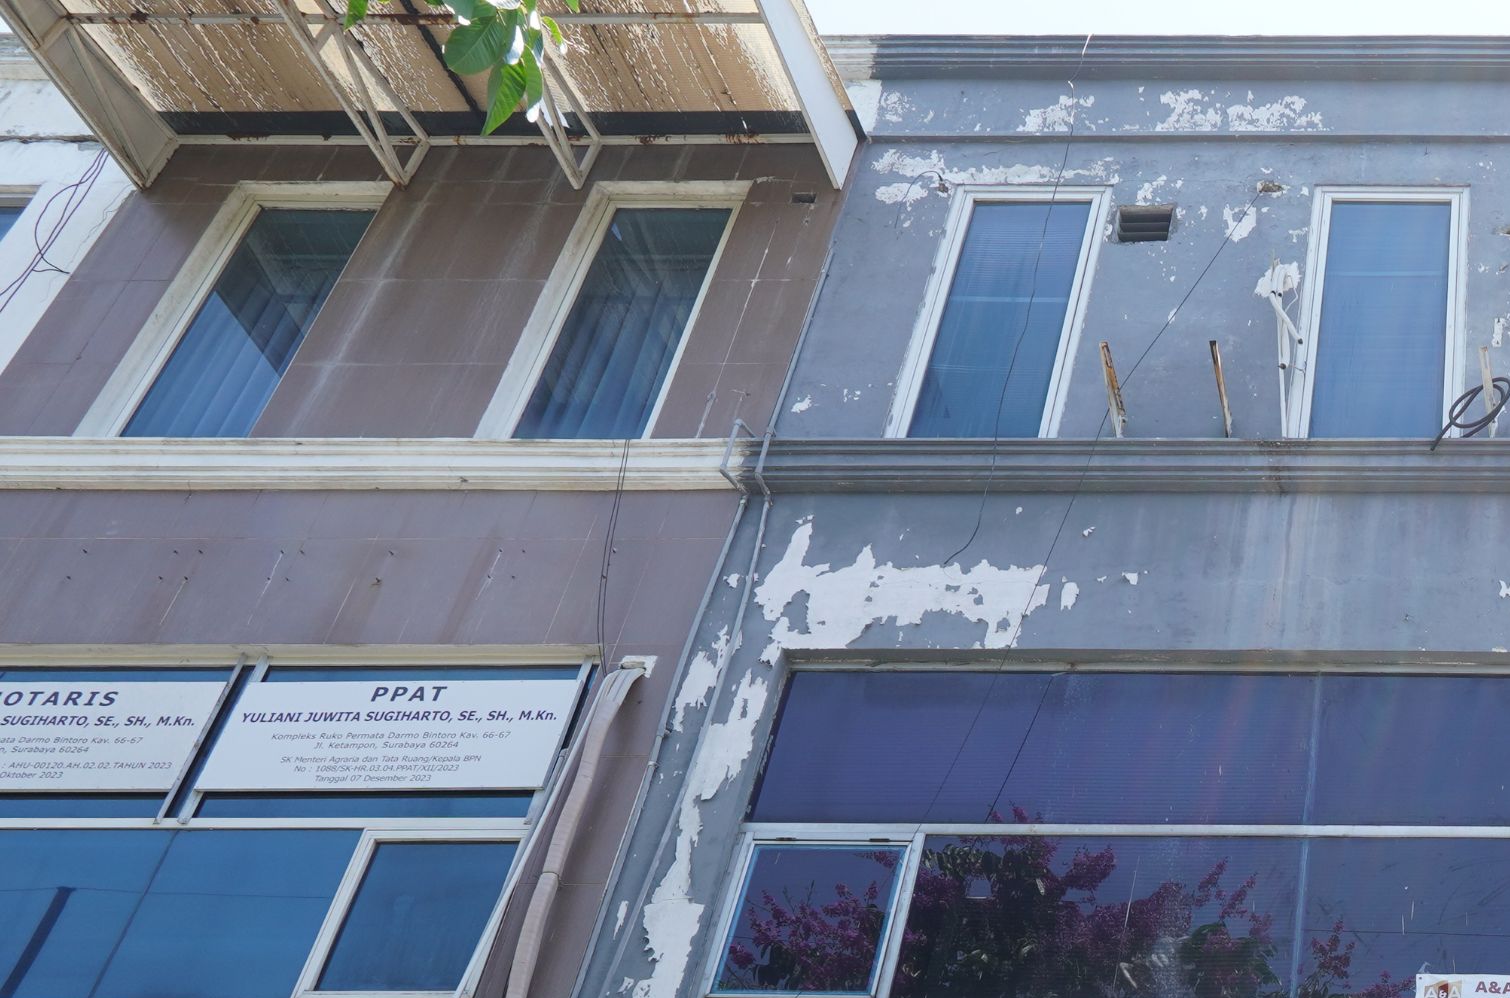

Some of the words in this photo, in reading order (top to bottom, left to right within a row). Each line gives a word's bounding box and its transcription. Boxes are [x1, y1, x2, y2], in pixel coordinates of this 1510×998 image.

[0, 691, 119, 706] OTARIS
[371, 686, 448, 702] PPAT
[0, 715, 89, 727] SUGIHARTO,
[94, 716, 120, 727] SE.,
[124, 716, 152, 727] SH.,
[156, 716, 196, 726] M.Kn.
[241, 712, 302, 722] YULIANI
[303, 712, 360, 722] JUWITA
[364, 711, 452, 723] SUGIHARTO,
[457, 710, 482, 722] SE.,
[486, 710, 514, 722] SH.,
[518, 710, 557, 721] M.Kn.
[18, 736, 51, 744] Darmo
[53, 736, 88, 744] Bintoro
[92, 736, 110, 744] Kav.
[114, 736, 144, 744] 66-67
[271, 732, 316, 742] Kompleks
[319, 732, 343, 740] Ruko
[346, 731, 385, 740] Permata
[388, 731, 419, 739] Darmo
[422, 730, 457, 739] Bintoro
[460, 731, 479, 739] Kav.
[482, 731, 512, 739] 66-67
[11, 745, 56, 754] Surabaya
[382, 741, 427, 749] Surabaya
[429, 741, 459, 749] 60264
[362, 755, 378, 763] dan
[408, 774, 432, 782] 2023
